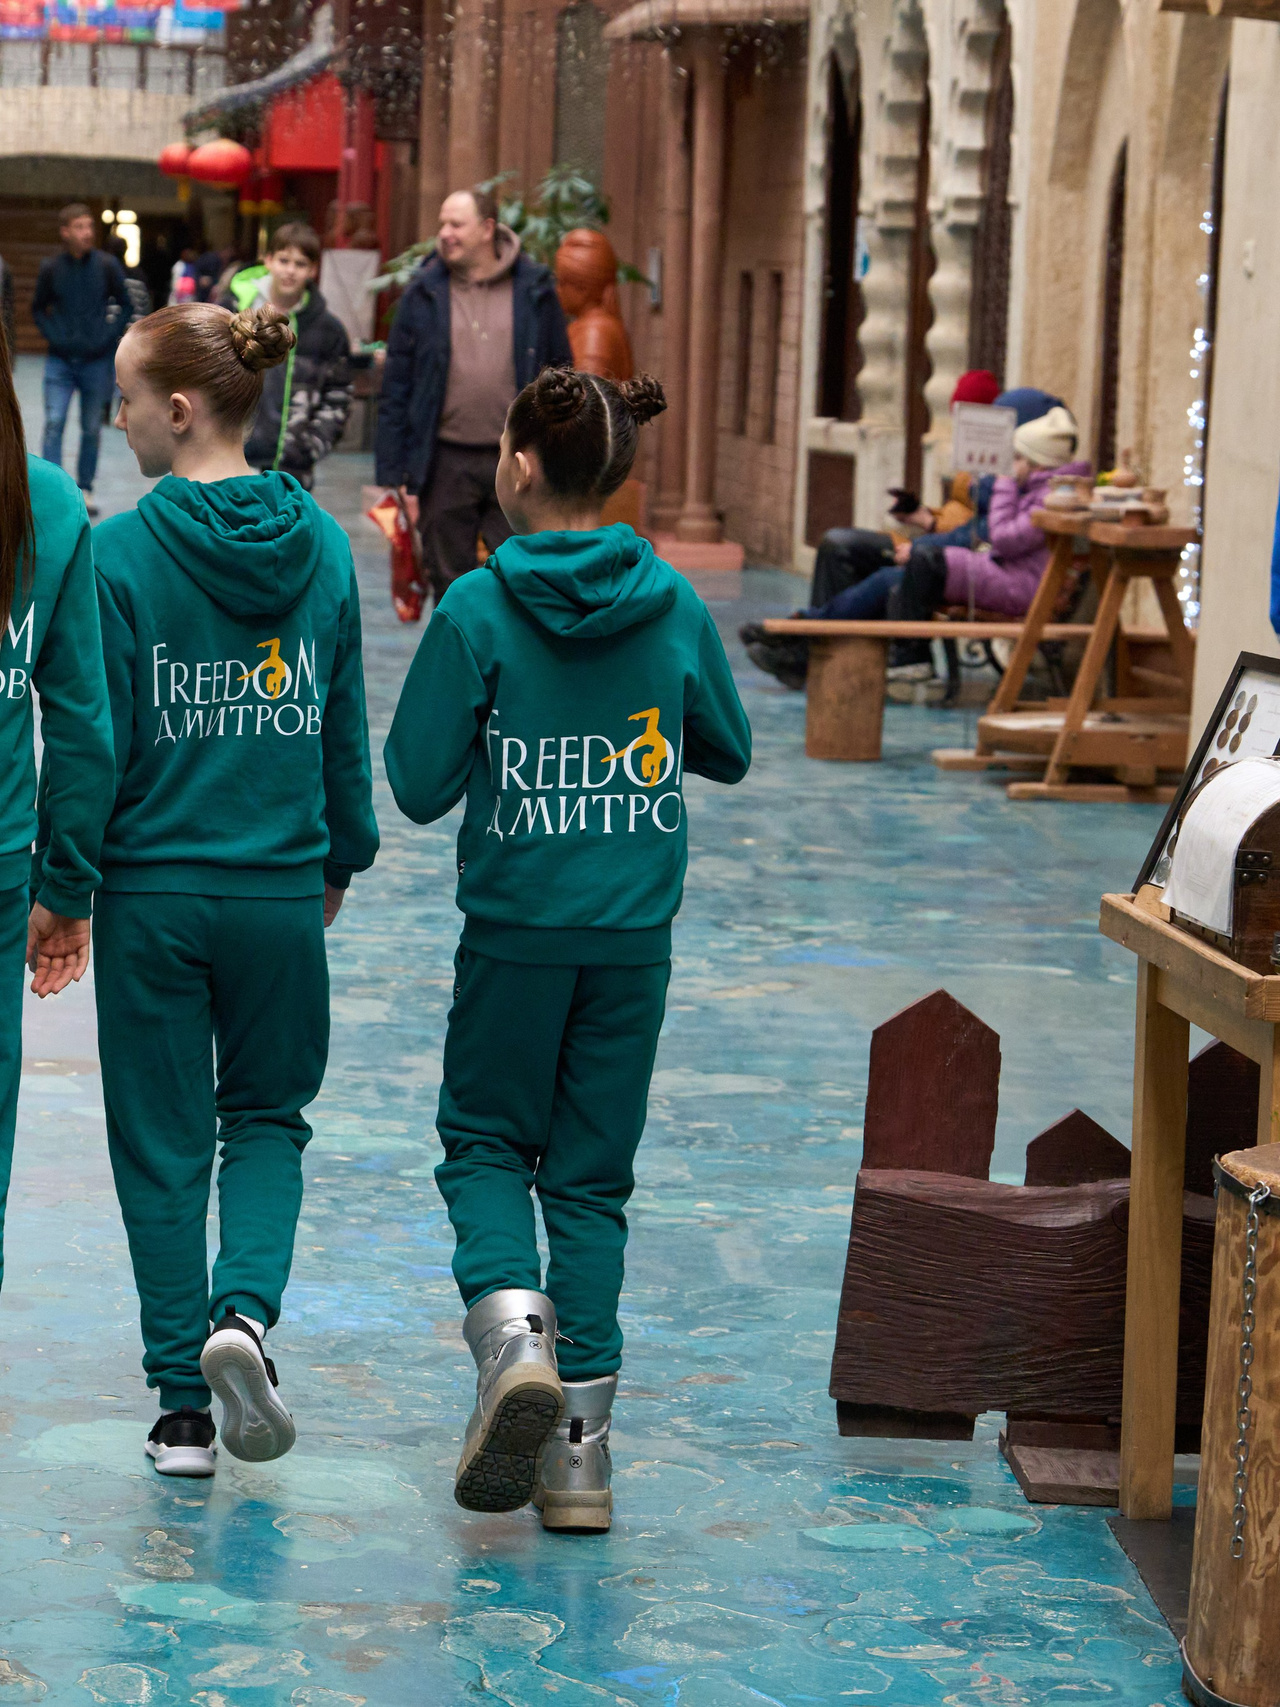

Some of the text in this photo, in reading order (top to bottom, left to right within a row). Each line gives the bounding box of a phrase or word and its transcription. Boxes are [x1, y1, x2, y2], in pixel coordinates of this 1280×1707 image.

[152, 636, 320, 707] FREEDOM
[154, 703, 322, 747] ДМИТРОВ
[486, 708, 684, 791] FREEDO
